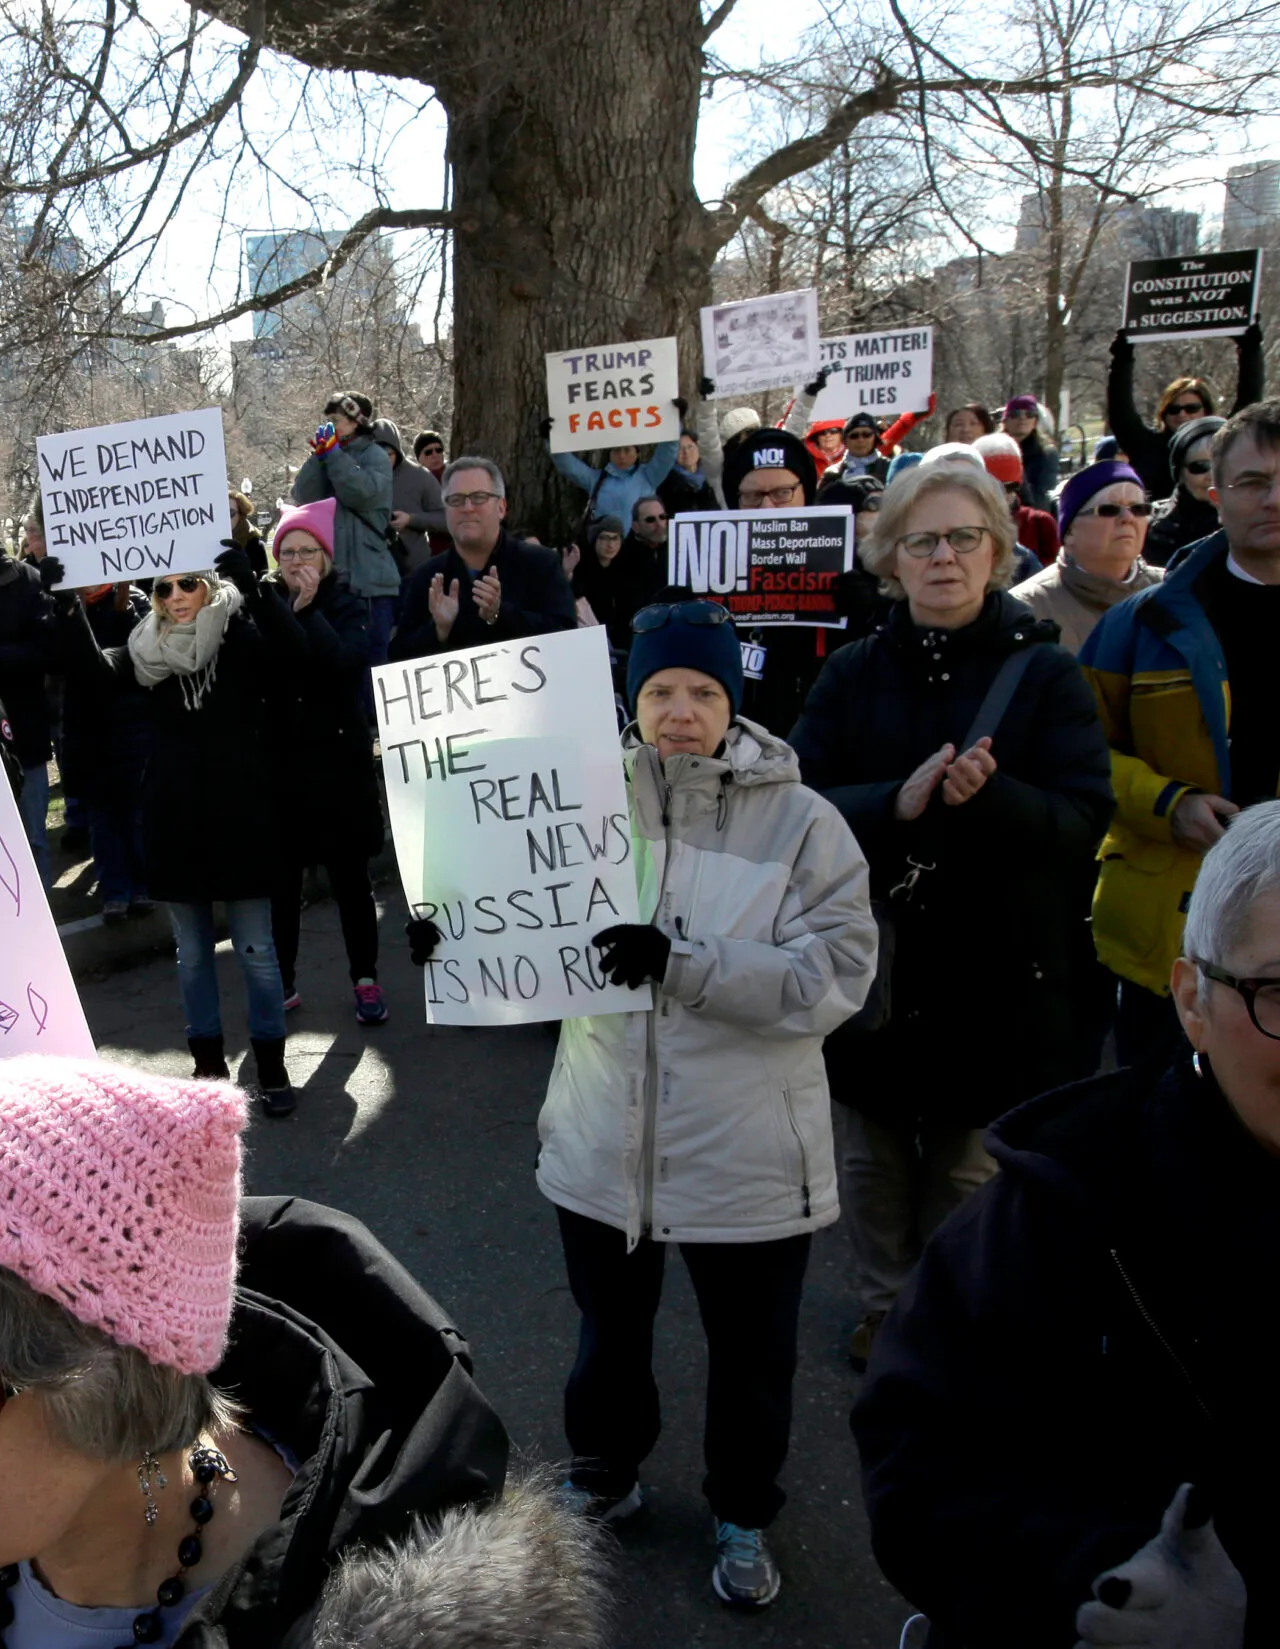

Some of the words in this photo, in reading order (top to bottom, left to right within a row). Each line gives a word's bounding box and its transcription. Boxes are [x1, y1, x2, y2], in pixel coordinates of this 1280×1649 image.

[1180, 261, 1206, 272] The
[1131, 270, 1253, 294] CONSTITUTION
[1150, 296, 1184, 306] was
[1187, 288, 1232, 303] NOT
[1128, 320, 1138, 328] a
[1140, 305, 1248, 328] SUGGESTION.
[854, 331, 928, 357] MATTER!
[562, 349, 653, 375] TRUMP
[844, 360, 912, 383] TRUMPS
[567, 373, 655, 404] FEARS
[859, 386, 897, 406] LIES
[568, 405, 662, 433] FACTS
[41, 446, 87, 482] WE
[96, 429, 206, 475] DEMAND
[753, 448, 785, 467] NO!
[47, 473, 205, 516] INDEPENDENT
[50, 503, 215, 546] INVESTIGATION
[751, 520, 788, 533] Muslim
[790, 520, 809, 532] Ban
[751, 538, 776, 549] Mass
[779, 535, 844, 550] Deportations
[100, 539, 176, 576] NOW
[677, 520, 749, 594] NO!
[751, 553, 784, 565] Border
[785, 552, 807, 565] Wall
[377, 645, 547, 726] HERE'S
[387, 728, 492, 783] THE
[469, 768, 583, 824] REAL
[526, 813, 631, 874] NEWS
[411, 877, 620, 941] RUSSIA
[424, 958, 470, 1004] IS
[478, 955, 540, 1001] NO
